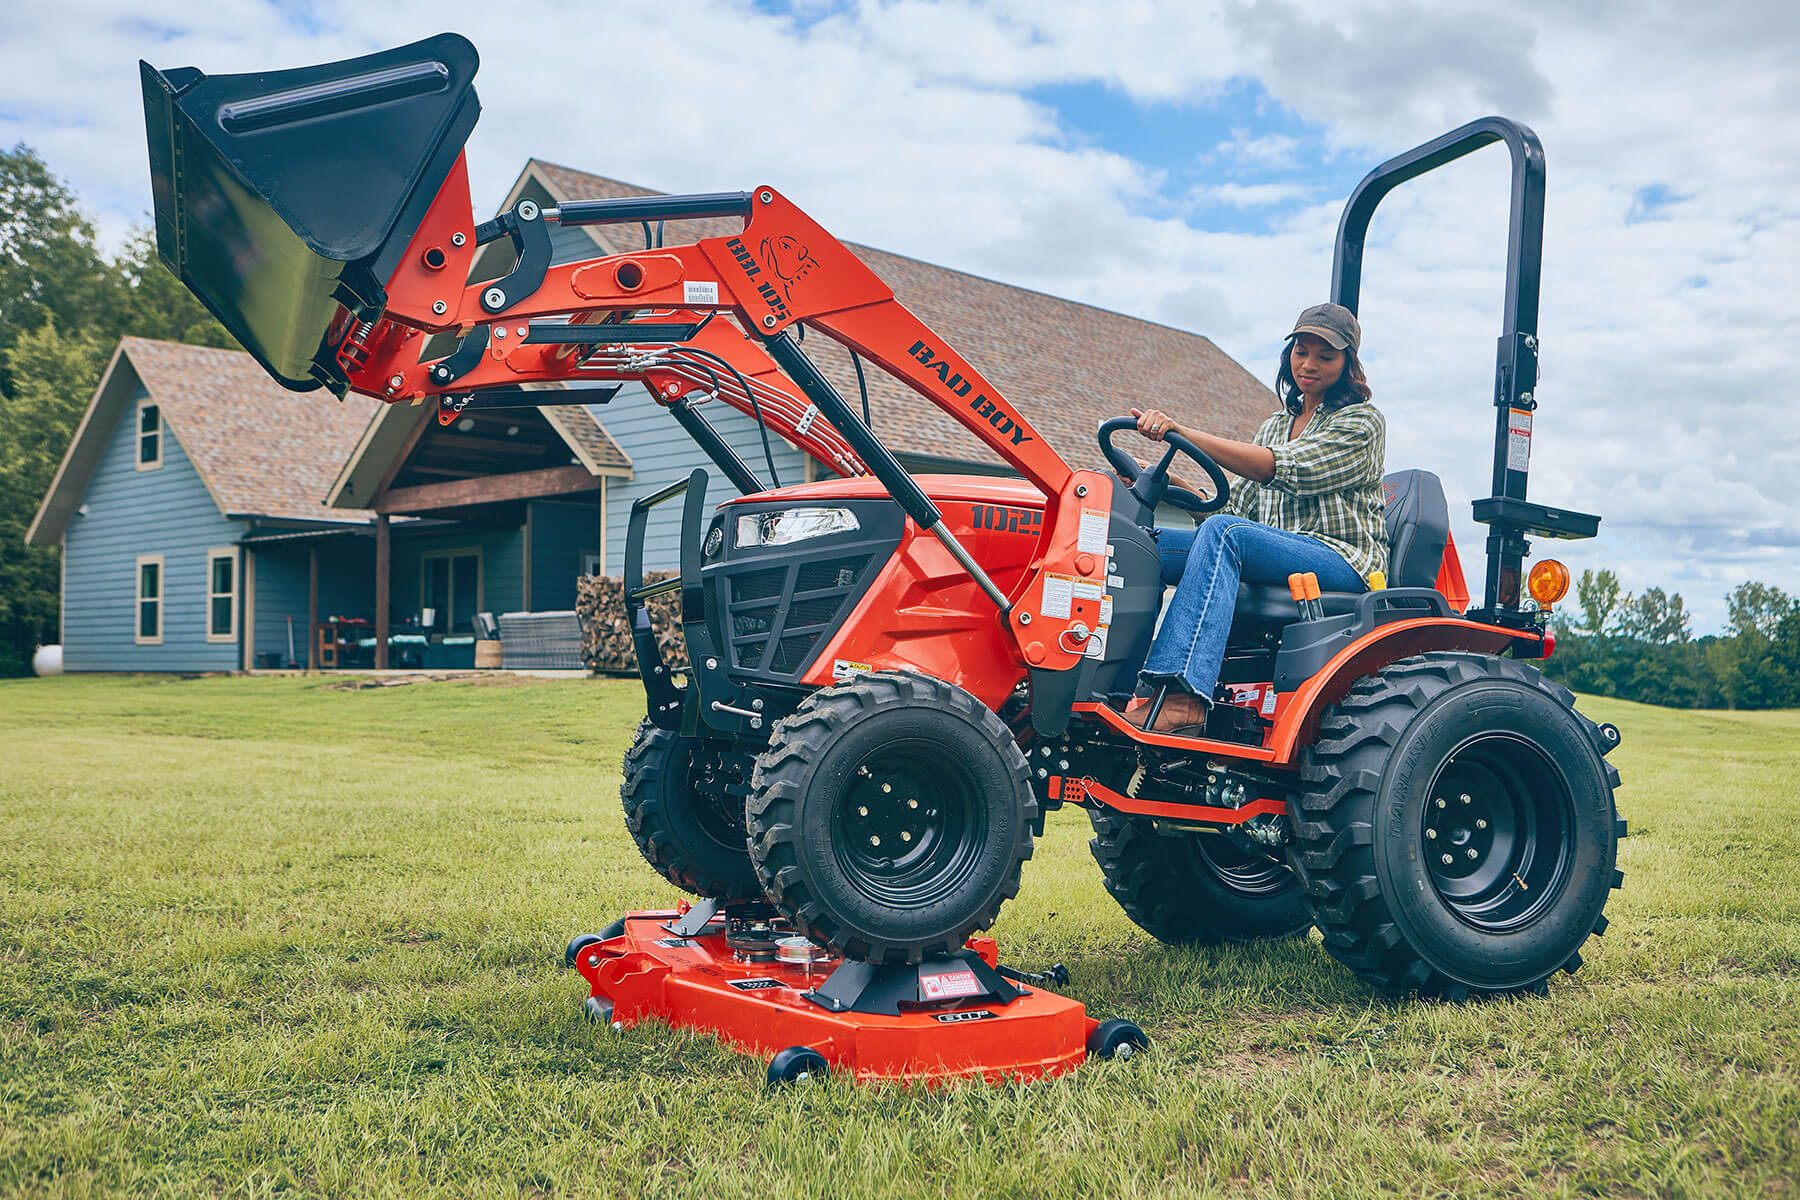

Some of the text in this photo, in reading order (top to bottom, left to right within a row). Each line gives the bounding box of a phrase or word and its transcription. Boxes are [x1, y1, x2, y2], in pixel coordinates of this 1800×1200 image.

[726, 238, 792, 321] BBL 105
[907, 340, 1033, 446] BAD BOY
